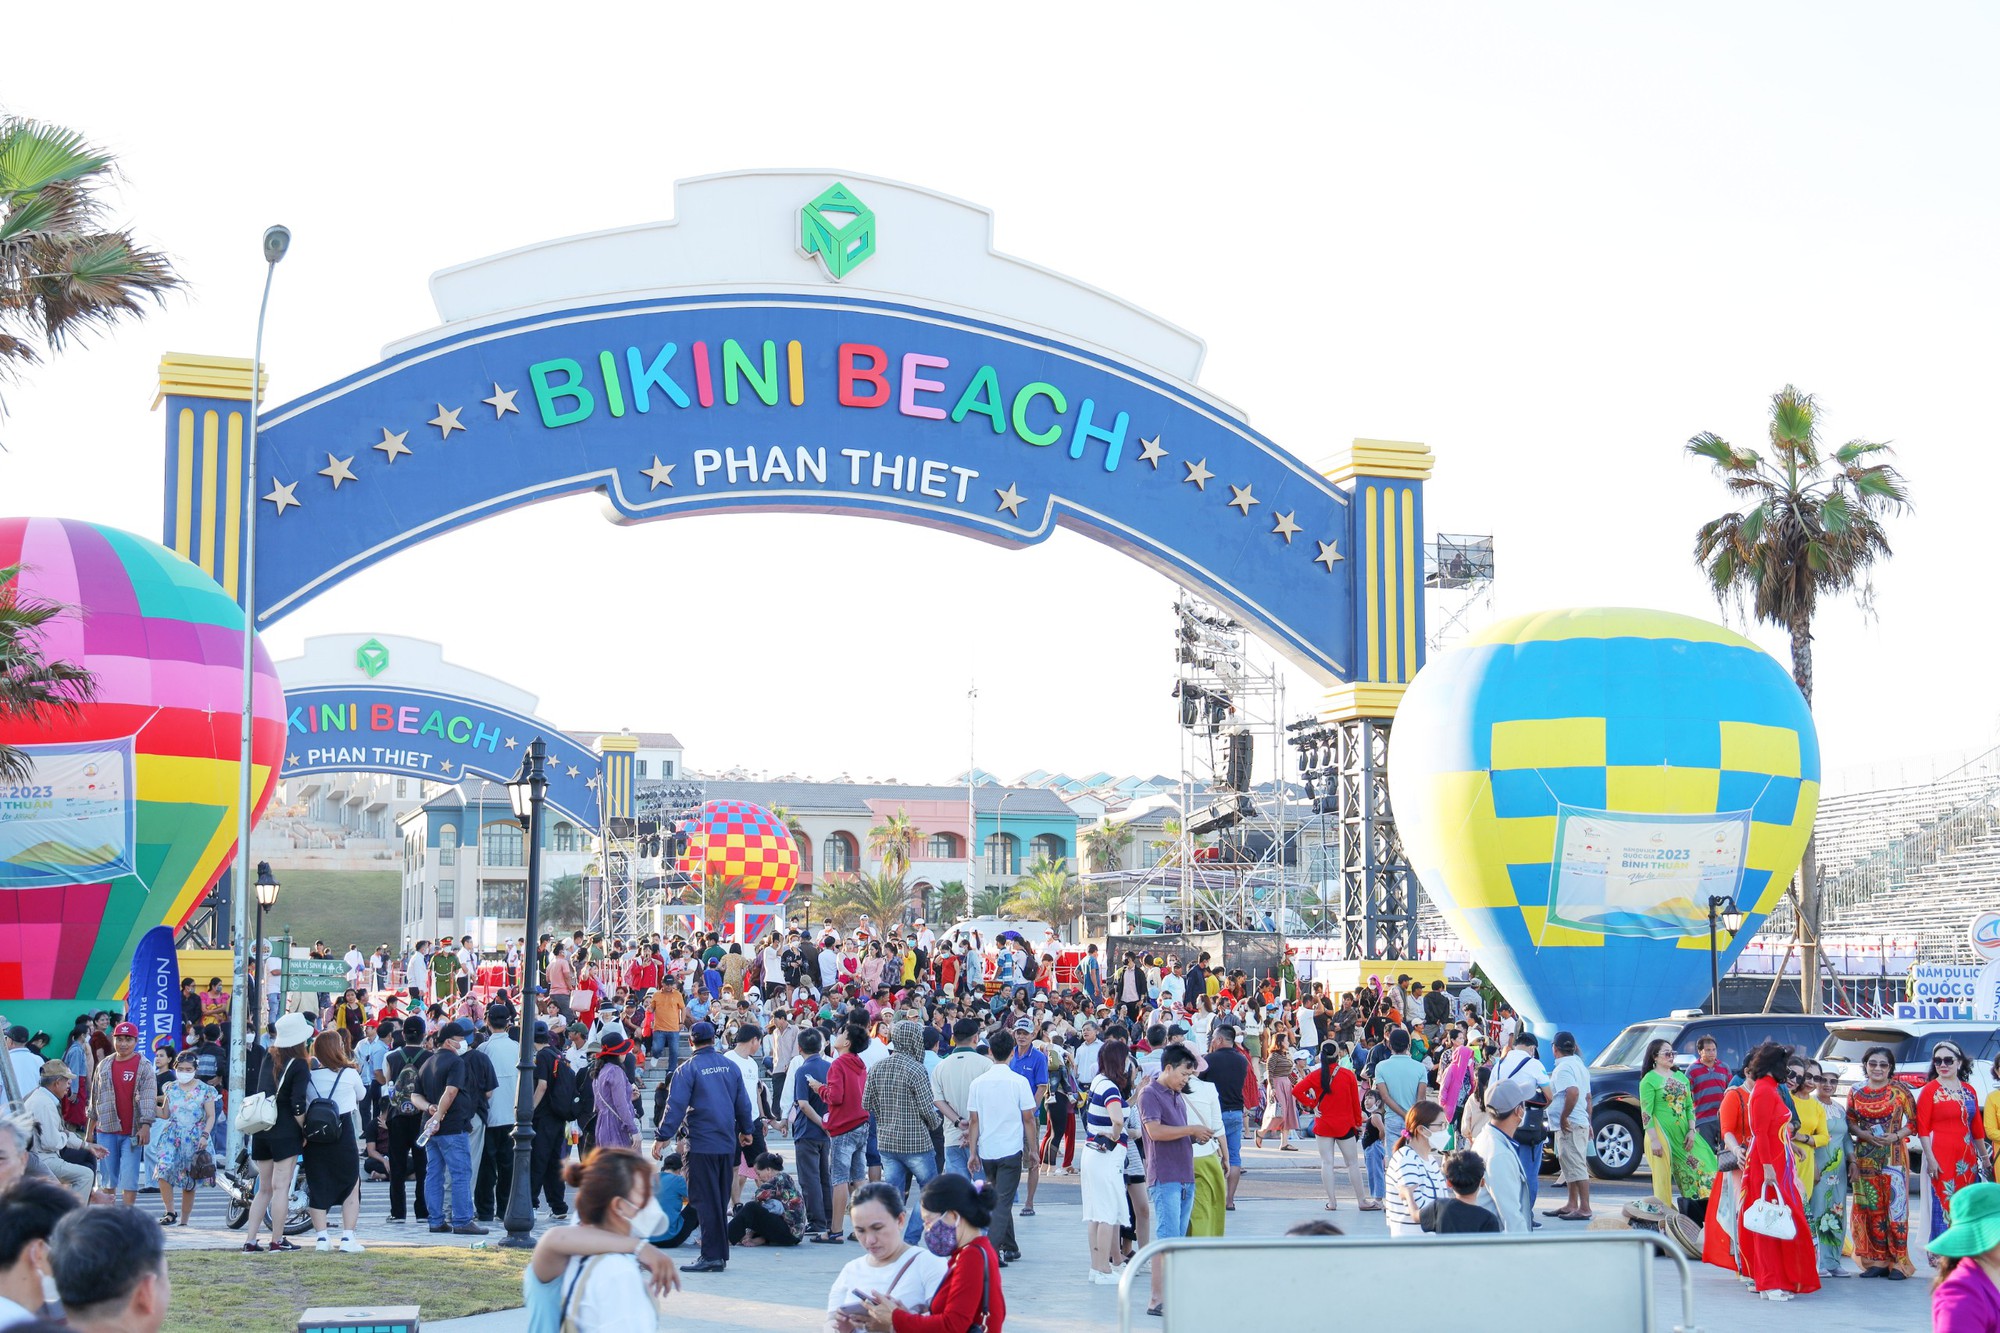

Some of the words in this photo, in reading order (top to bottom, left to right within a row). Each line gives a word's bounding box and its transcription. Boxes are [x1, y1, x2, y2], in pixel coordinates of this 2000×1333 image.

[529, 339, 803, 429] BIKINI
[836, 342, 1130, 472] BEACH
[694, 446, 827, 486] PHAN
[841, 449, 979, 503] THIET
[286, 703, 357, 737] KINI
[370, 703, 501, 753] BEACH
[307, 747, 366, 765] PHAN
[372, 747, 433, 769] THIET
[10, 786, 53, 799] 2023
[1621, 859, 1649, 869] BÌNH
[1656, 849, 1690, 860] 2023
[1917, 966, 1943, 978] NĂM
[1945, 968, 1961, 978] DU
[1963, 968, 1980, 980] LỊC
[1917, 978, 1961, 996] QUỐC
[140, 997, 148, 1026] PHAN
[1898, 1000, 1973, 1020] BÌNH
[138, 1030, 147, 1055] THIE
[123, 1073, 135, 1082] 37
[701, 1066, 730, 1076] SECURTY
